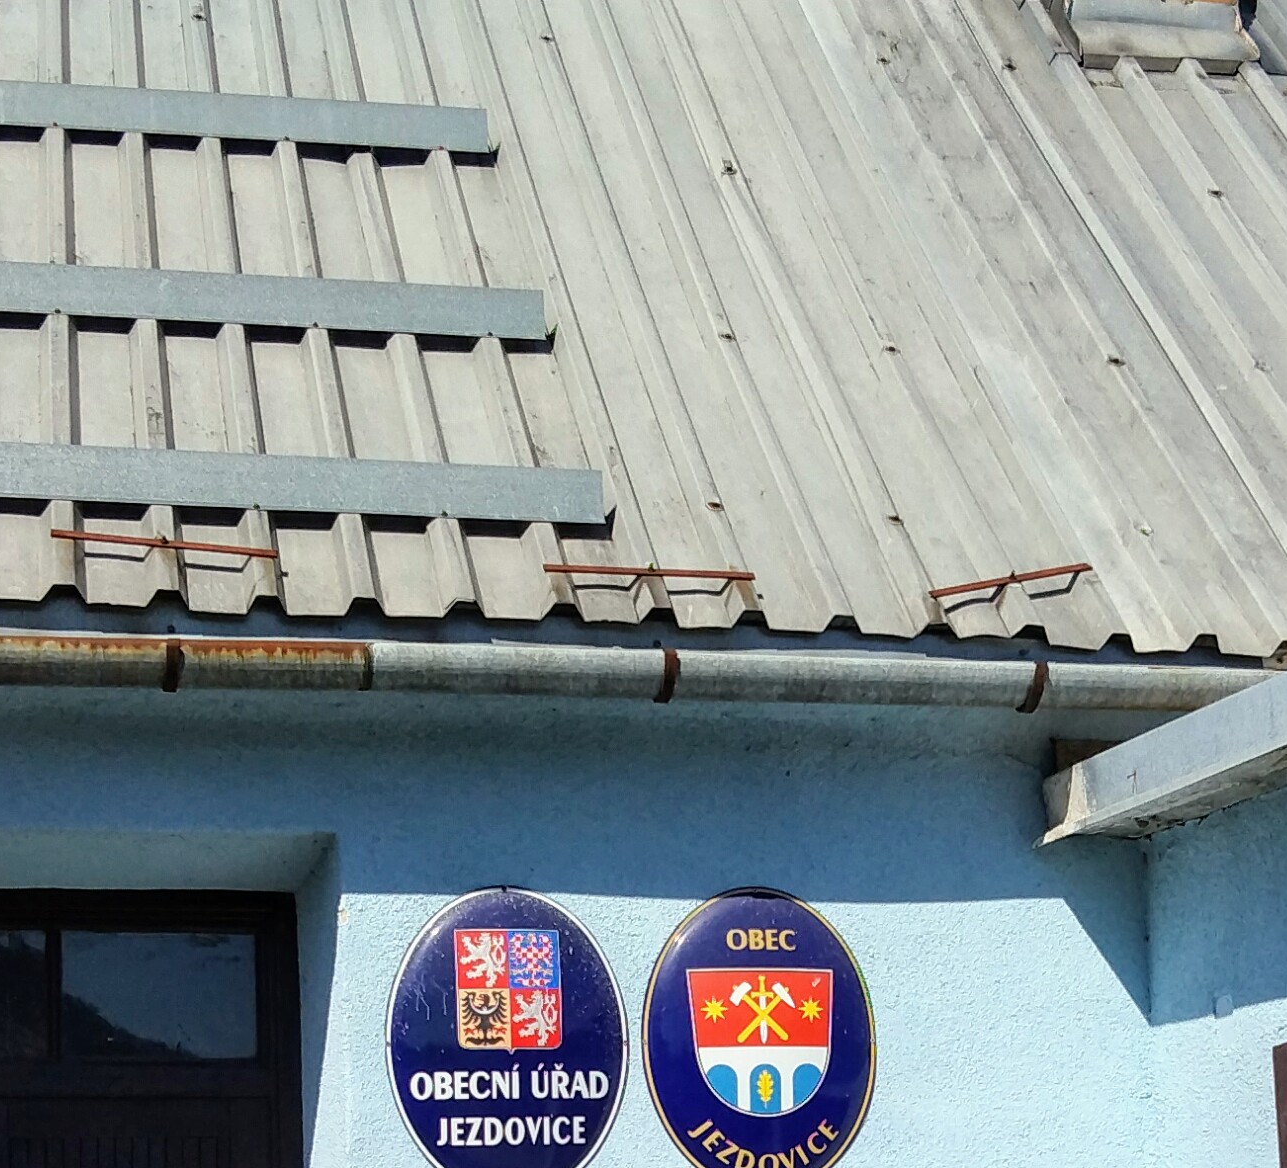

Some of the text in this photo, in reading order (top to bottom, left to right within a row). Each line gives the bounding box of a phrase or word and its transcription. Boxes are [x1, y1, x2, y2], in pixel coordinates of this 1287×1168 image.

[726, 928, 797, 952] OBEC
[409, 1062, 610, 1101] OBECNÍ ÚŘAD
[436, 1115, 587, 1147] JEZDOVICE
